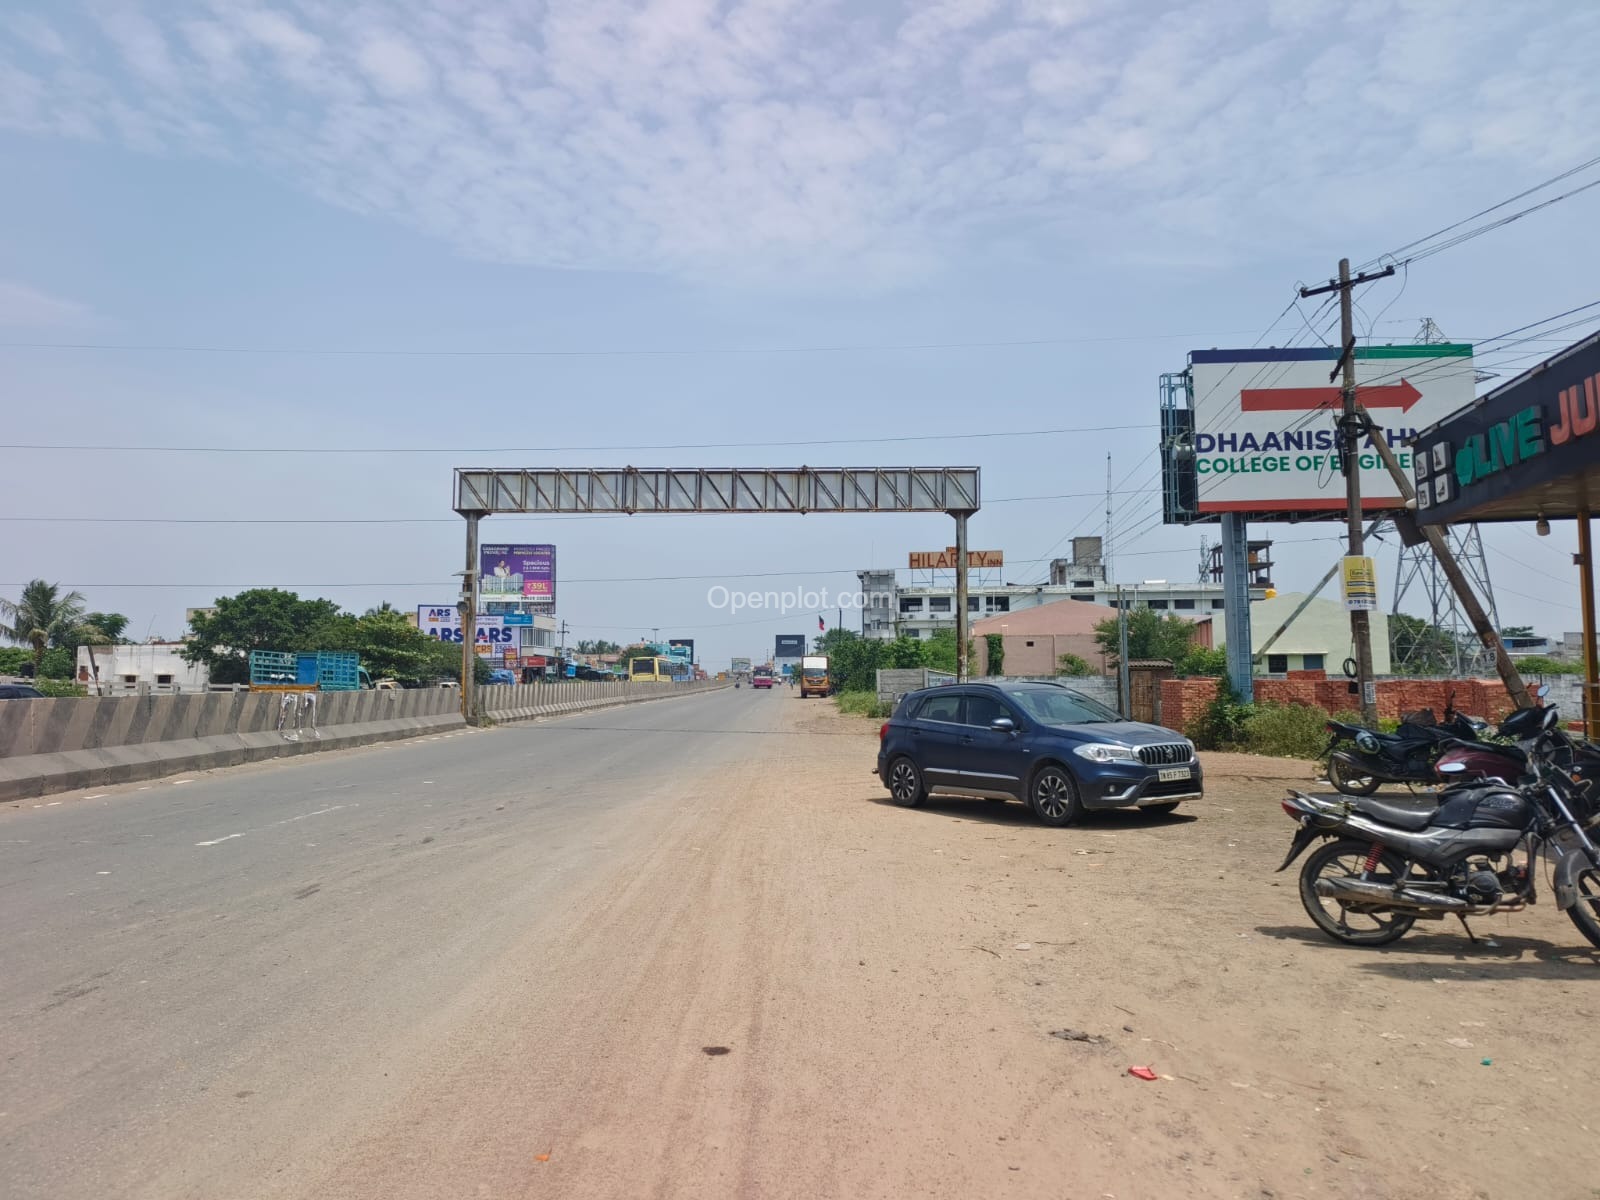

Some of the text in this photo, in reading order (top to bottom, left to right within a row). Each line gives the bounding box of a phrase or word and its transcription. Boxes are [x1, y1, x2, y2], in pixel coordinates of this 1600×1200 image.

[1550, 372, 1600, 445] JU
[1196, 456, 1291, 474] COLLEGE
[1295, 455, 1325, 471] OF
[909, 551, 987, 568] HILARTY
[429, 608, 450, 617] ARS
[428, 627, 464, 643] ARS
[475, 627, 512, 643] ARS
